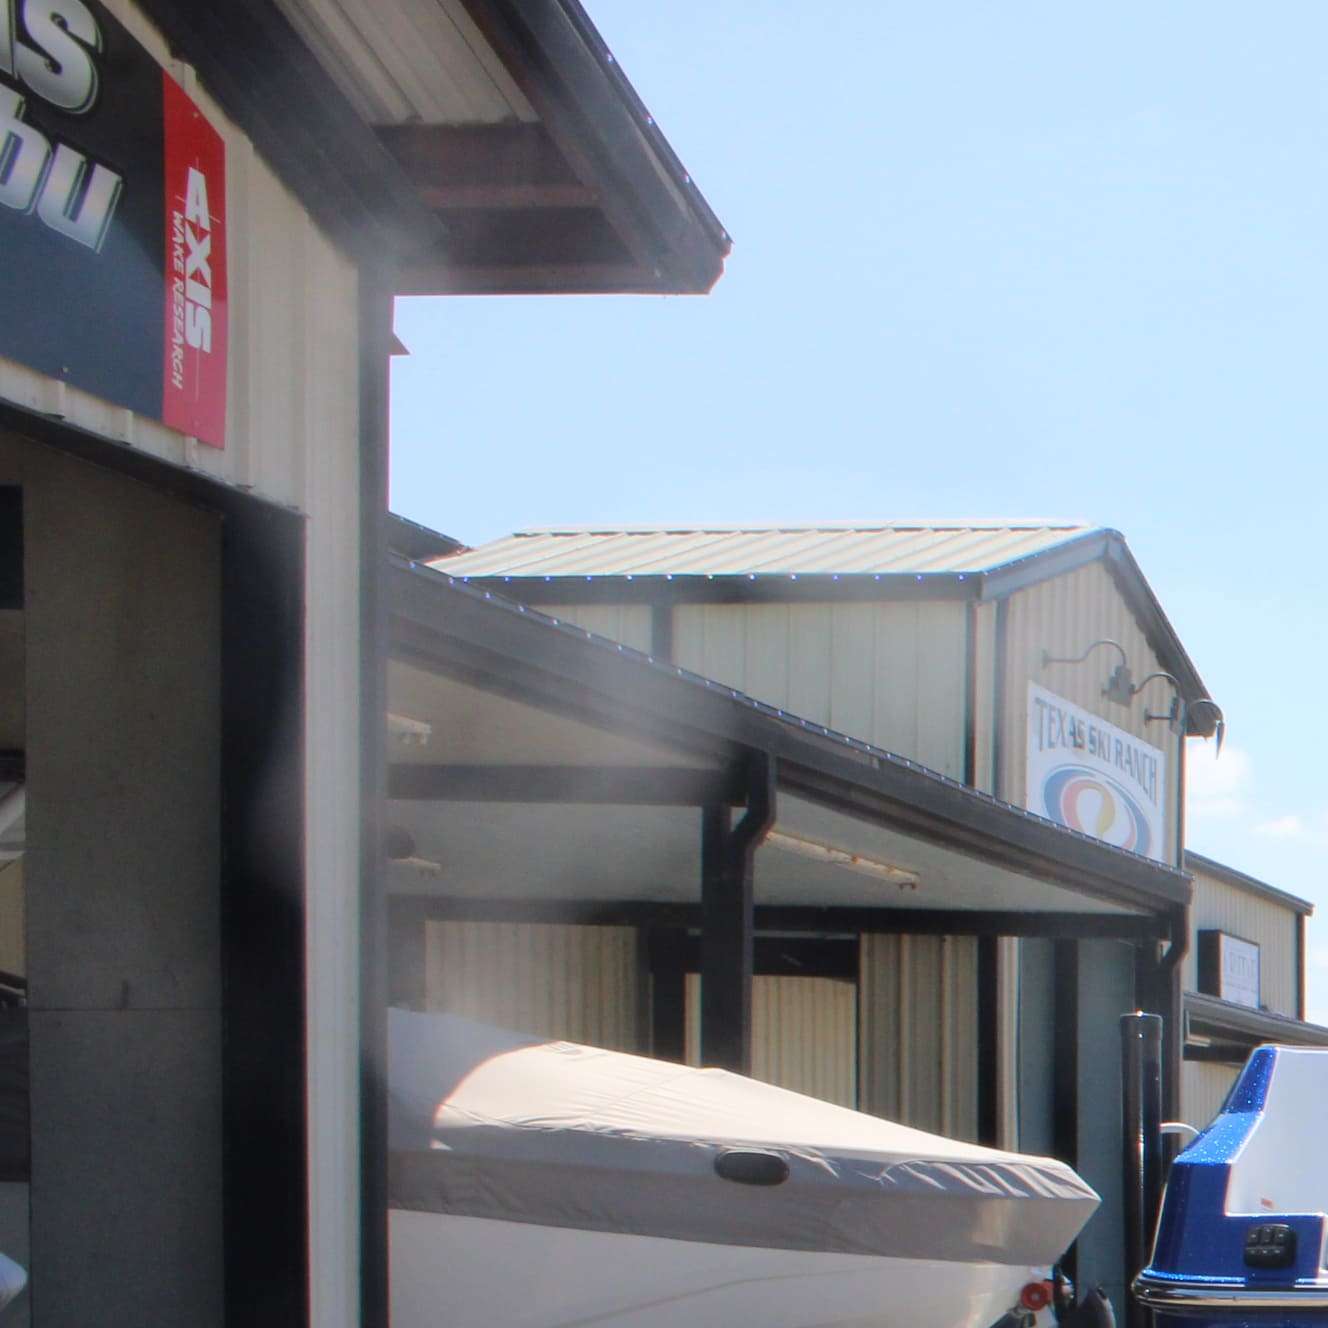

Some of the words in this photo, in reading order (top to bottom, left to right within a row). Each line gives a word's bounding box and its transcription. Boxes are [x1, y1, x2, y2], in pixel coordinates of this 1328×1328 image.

[172, 210, 185, 272] WAKE
[184, 166, 212, 353] AXIS
[171, 276, 185, 390] RESEARCH
[1034, 697, 1085, 752] TEXAS
[1088, 723, 1111, 763] SKI
[1114, 738, 1158, 808] RANCH
